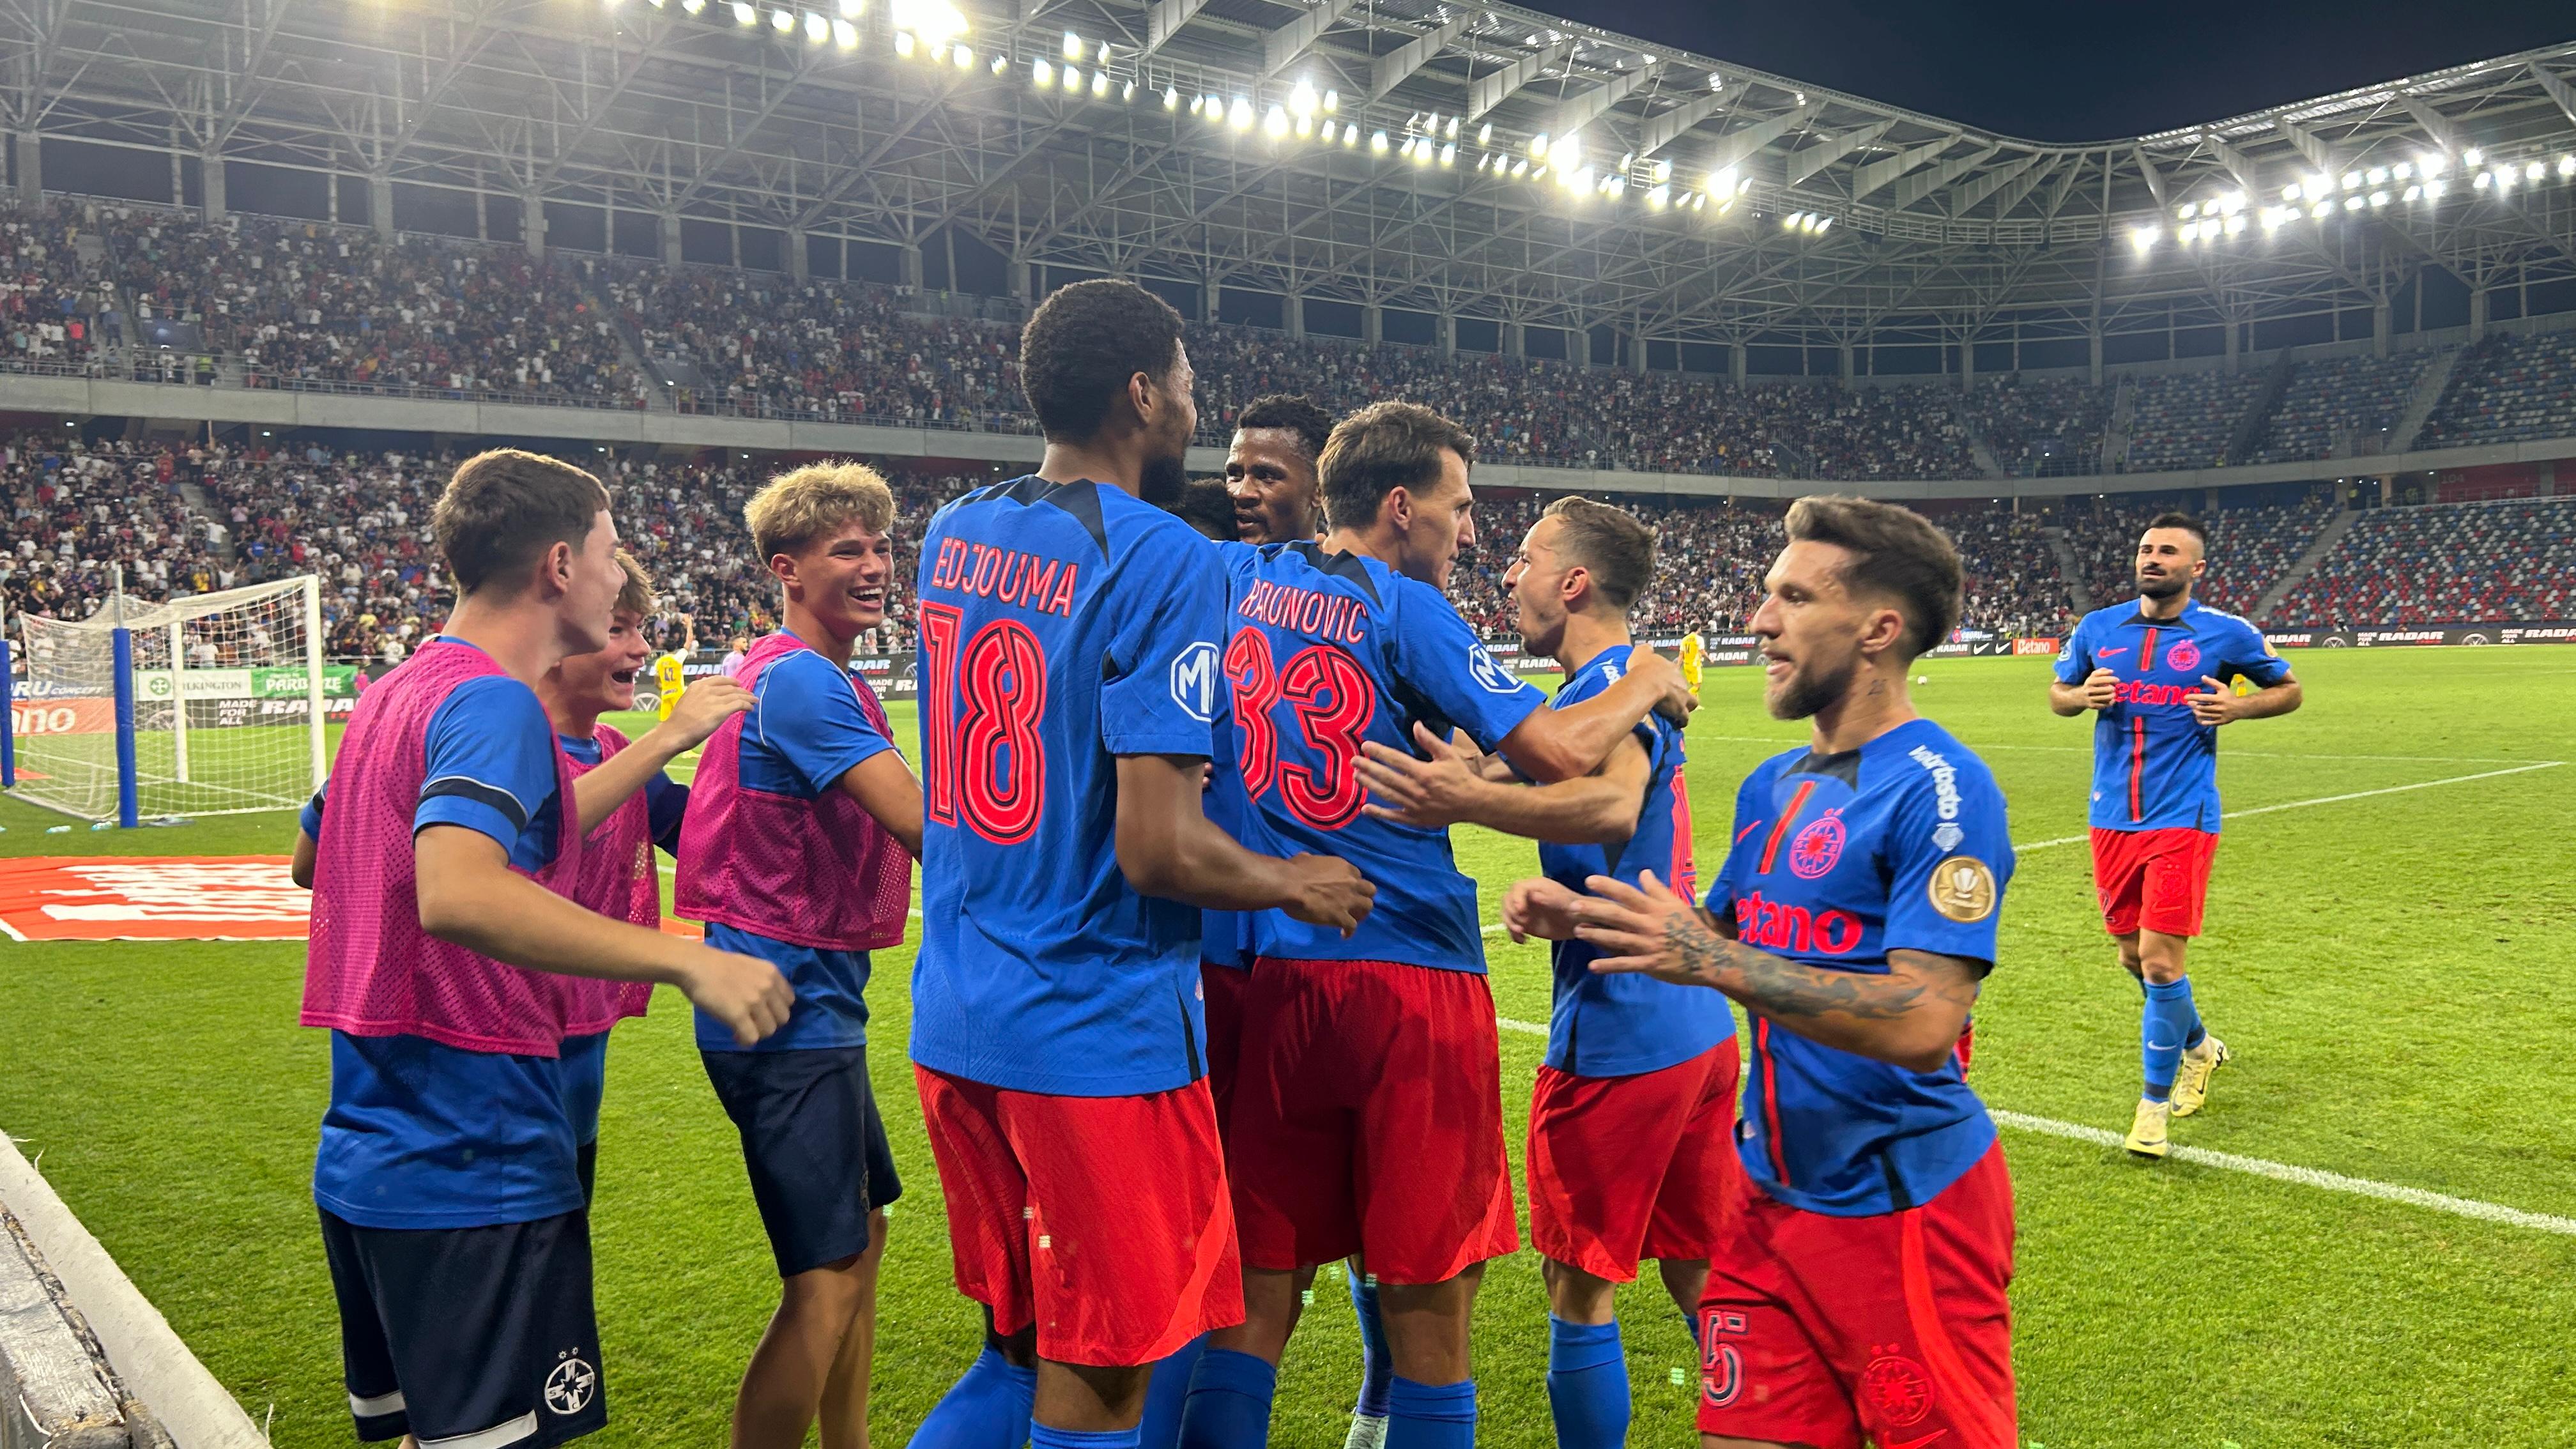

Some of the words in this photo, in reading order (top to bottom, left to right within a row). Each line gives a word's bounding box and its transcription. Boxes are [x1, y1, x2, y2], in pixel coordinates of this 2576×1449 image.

[931, 537, 1078, 618] EDJOUMA
[2379, 631, 2444, 641] RADAR
[2017, 639, 2050, 654] Betano
[1708, 652, 1749, 661] RADAR
[51, 686, 103, 695] CONCEPT
[218, 700, 257, 709] MADE
[219, 709, 247, 717] FOR
[219, 717, 243, 725] ALL
[920, 599, 1046, 846] 18
[1223, 625, 1376, 831] 33
[1736, 891, 1863, 954] etano
